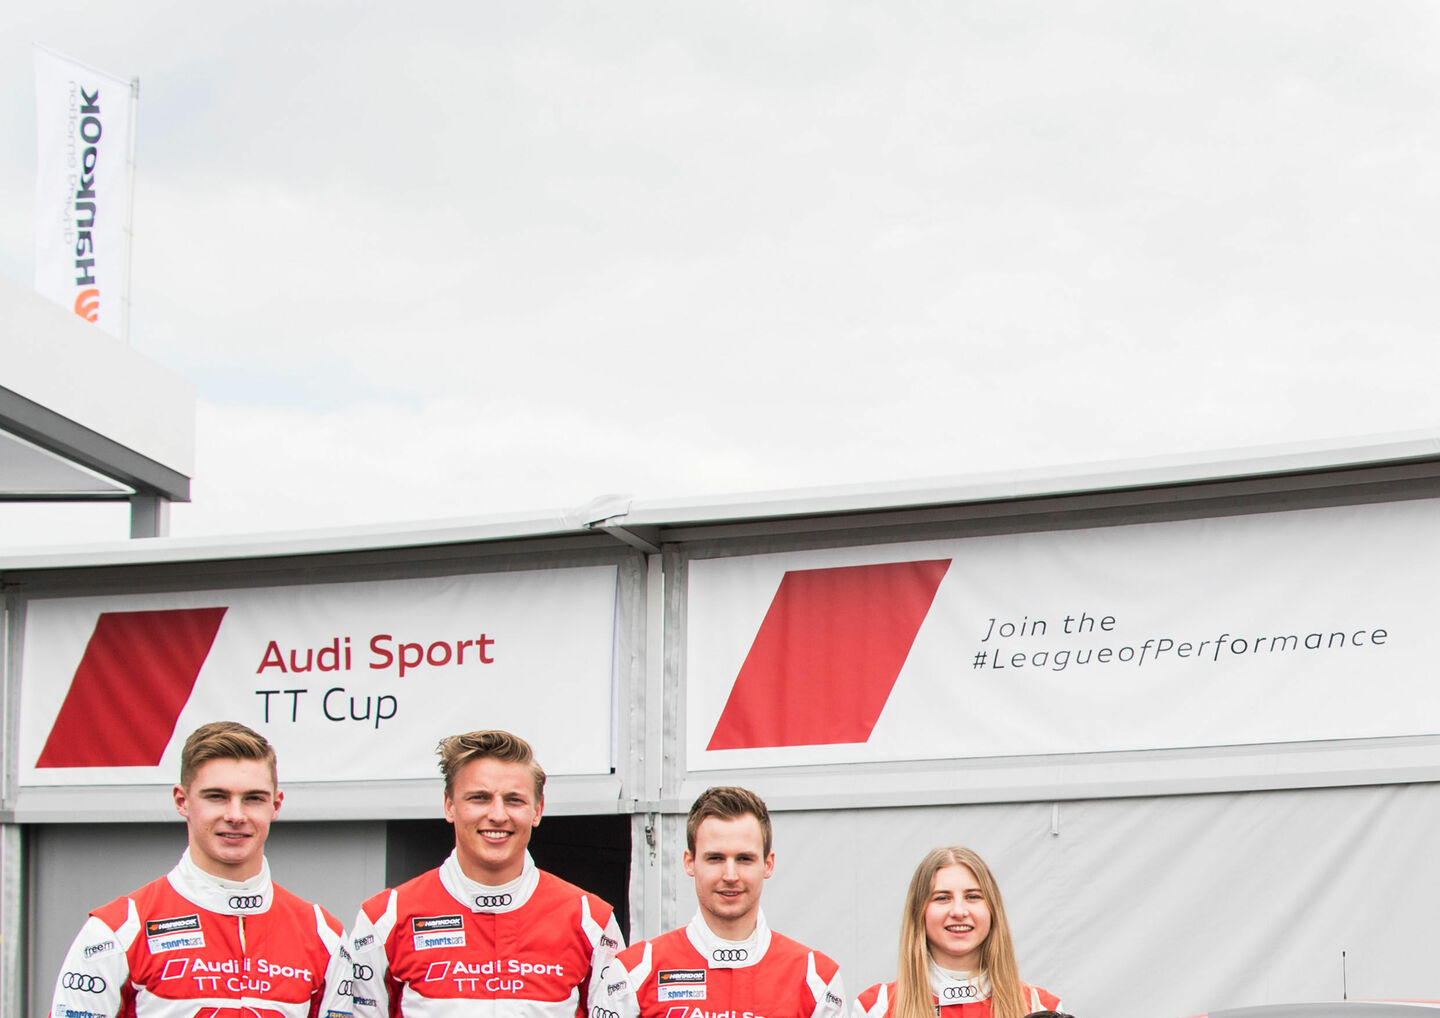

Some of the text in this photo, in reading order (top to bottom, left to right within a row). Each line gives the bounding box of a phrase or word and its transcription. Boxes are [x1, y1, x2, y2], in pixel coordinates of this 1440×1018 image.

[982, 612, 1116, 642] Join the
[256, 633, 494, 677] Audi Sport
[973, 627, 1389, 672] #LeagueofPerformance
[255, 687, 397, 729] TT Cup
[192, 959, 312, 981] Audi Sport
[452, 960, 563, 976] Audi Sport
[193, 976, 271, 994] TT Cup
[453, 977, 524, 993] TT Cup
